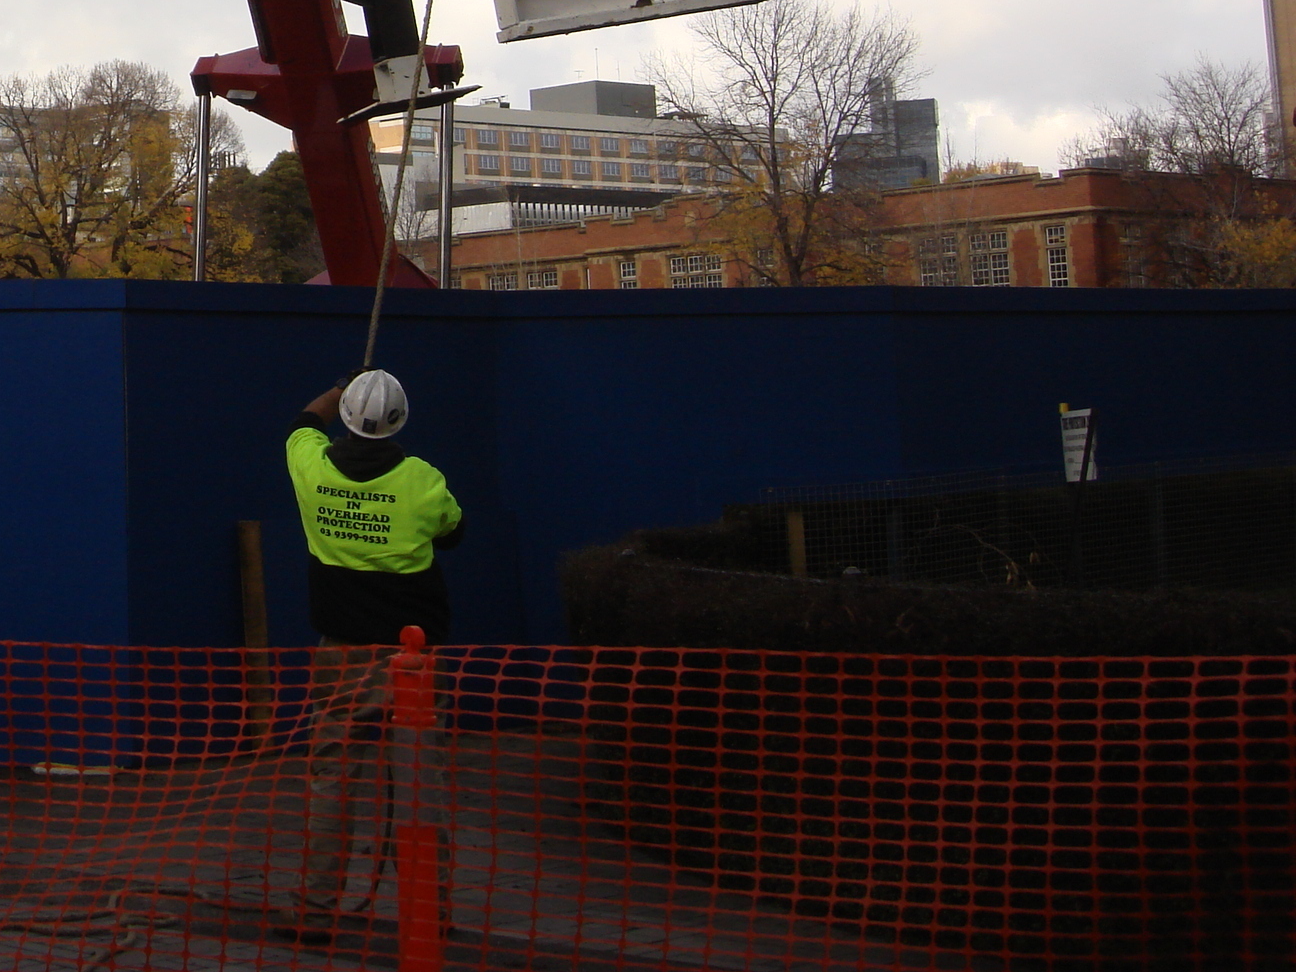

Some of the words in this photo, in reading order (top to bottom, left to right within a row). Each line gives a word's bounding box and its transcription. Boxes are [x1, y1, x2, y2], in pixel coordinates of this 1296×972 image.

[316, 485, 396, 503] SPECIALISTS
[346, 501, 361, 510] IN
[318, 506, 390, 523] OVERHEAD
[316, 515, 391, 533] PROTECTION
[320, 528, 331, 537] 03
[334, 531, 388, 544] 9399-9533
